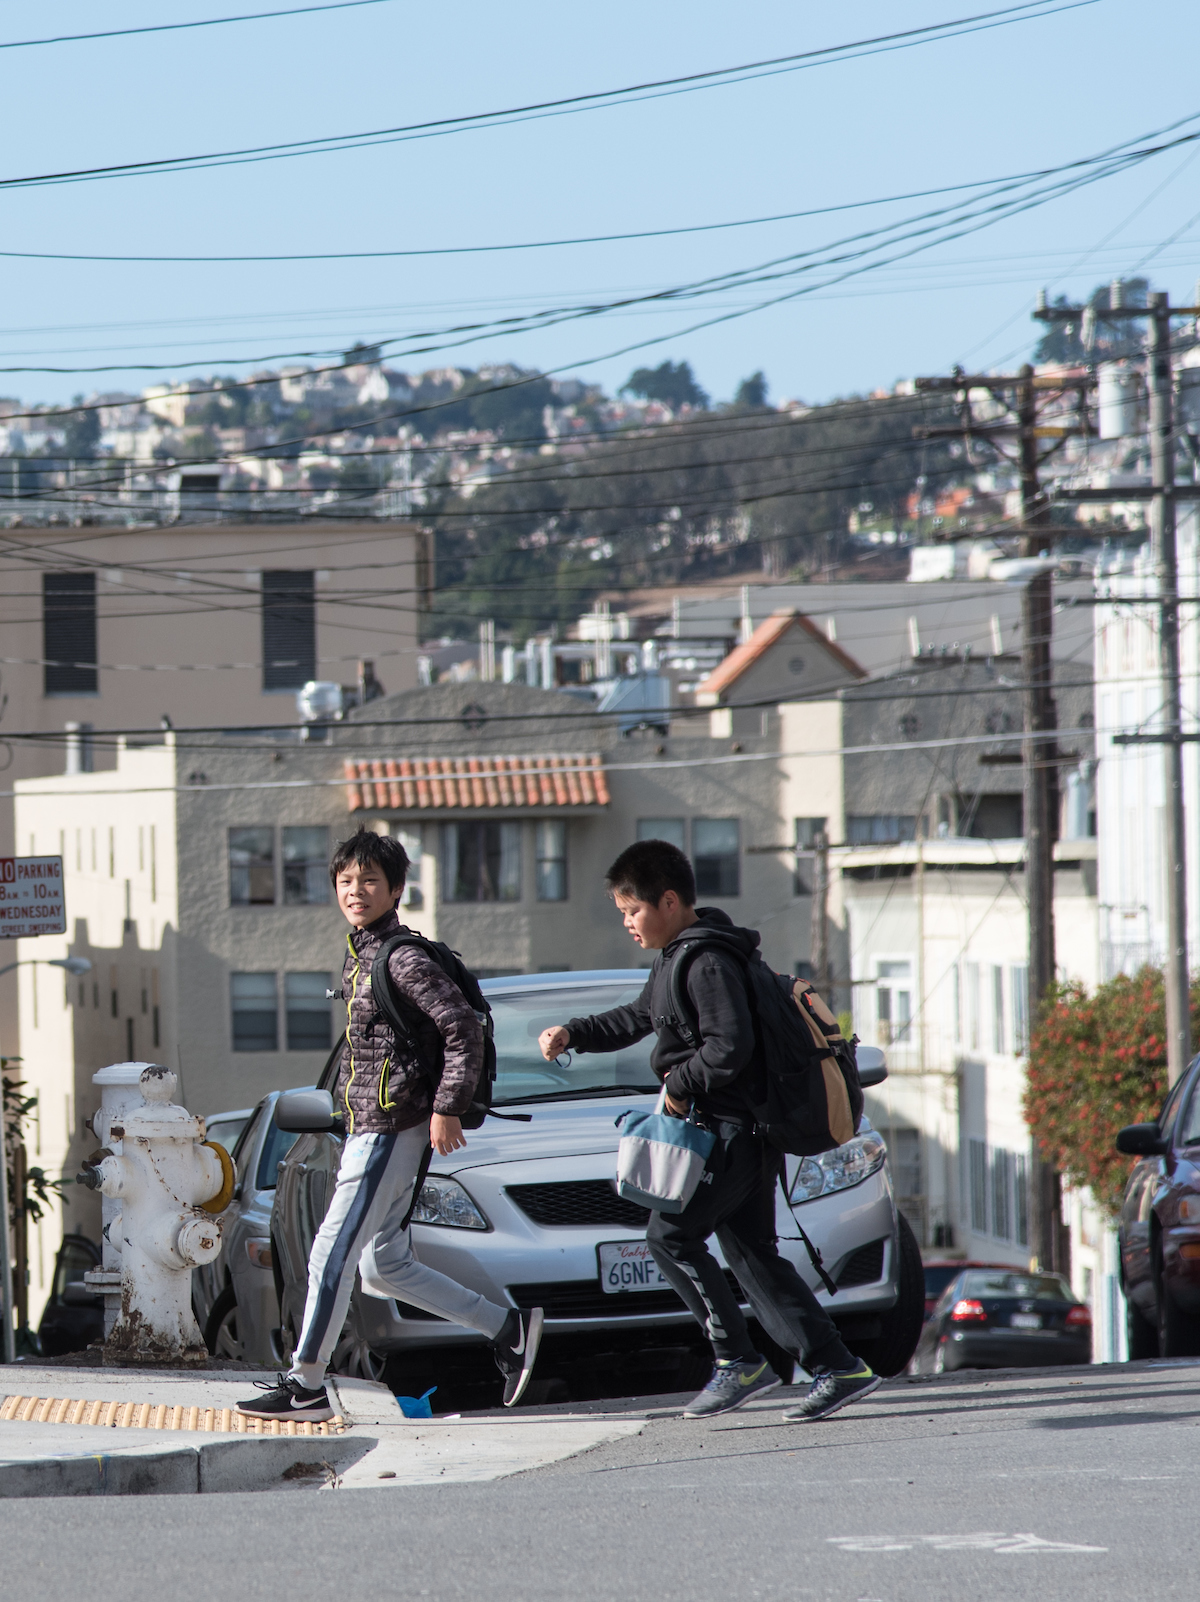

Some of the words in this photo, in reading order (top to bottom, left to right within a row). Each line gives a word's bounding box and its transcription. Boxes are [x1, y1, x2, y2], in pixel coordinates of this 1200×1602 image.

[18, 863, 60, 879] PARKING
[1, 924, 25, 934] STREET
[28, 923, 62, 932] SWEEPING
[608, 1260, 666, 1286] 6GNF
